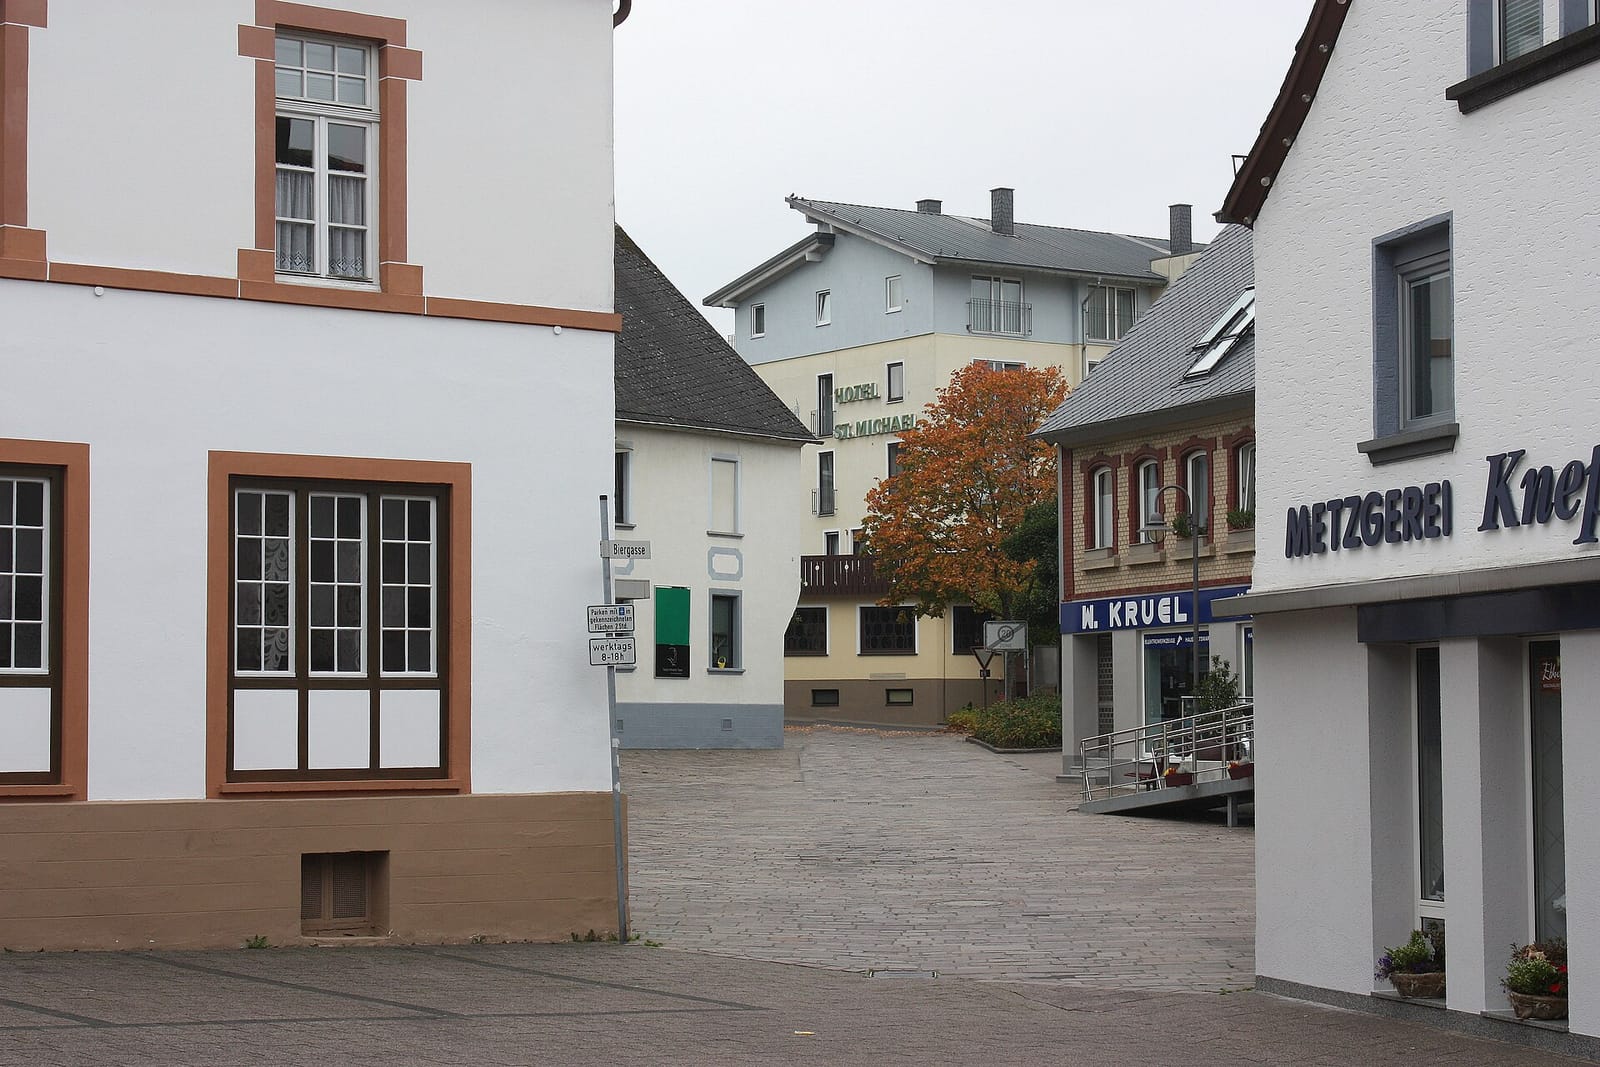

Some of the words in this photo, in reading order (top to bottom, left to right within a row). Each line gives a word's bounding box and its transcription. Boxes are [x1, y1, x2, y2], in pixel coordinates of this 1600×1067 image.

[834, 382, 881, 405] HOTEL
[833, 421, 854, 441] ST.
[856, 413, 920, 438] MICHAEL
[1284, 479, 1453, 559] METZGEREI
[613, 543, 646, 558] Biergasse
[1109, 596, 1188, 628] KRUEL
[592, 643, 632, 652] werktags
[601, 652, 625, 661] 8-18h
